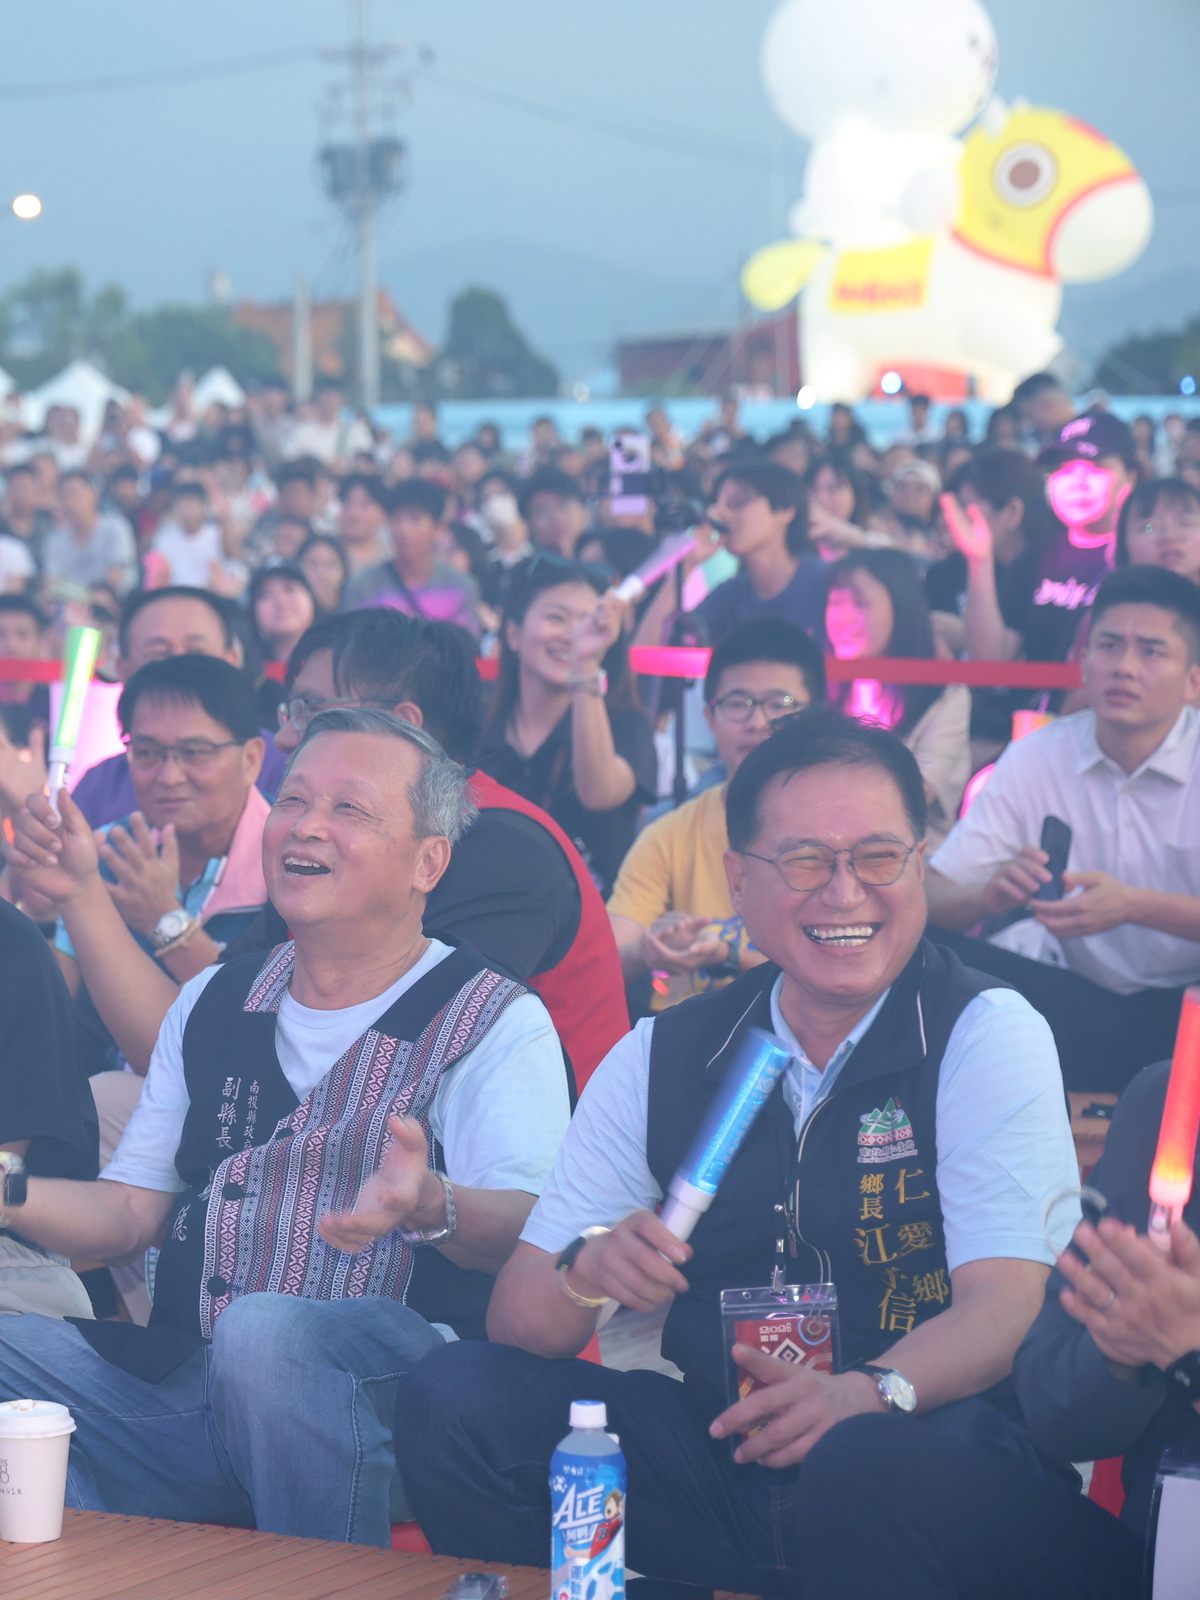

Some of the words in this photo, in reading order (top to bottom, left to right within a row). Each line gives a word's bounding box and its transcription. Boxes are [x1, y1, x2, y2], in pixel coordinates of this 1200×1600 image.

[215, 1076, 242, 1151] 副縣長
[859, 1173, 885, 1221] 鄉長
[894, 1168, 950, 1305] 仁愛鄉
[759, 1322, 792, 1334] 2026
[553, 1483, 605, 1529] ALE
[570, 1565, 582, 1600] 運動
